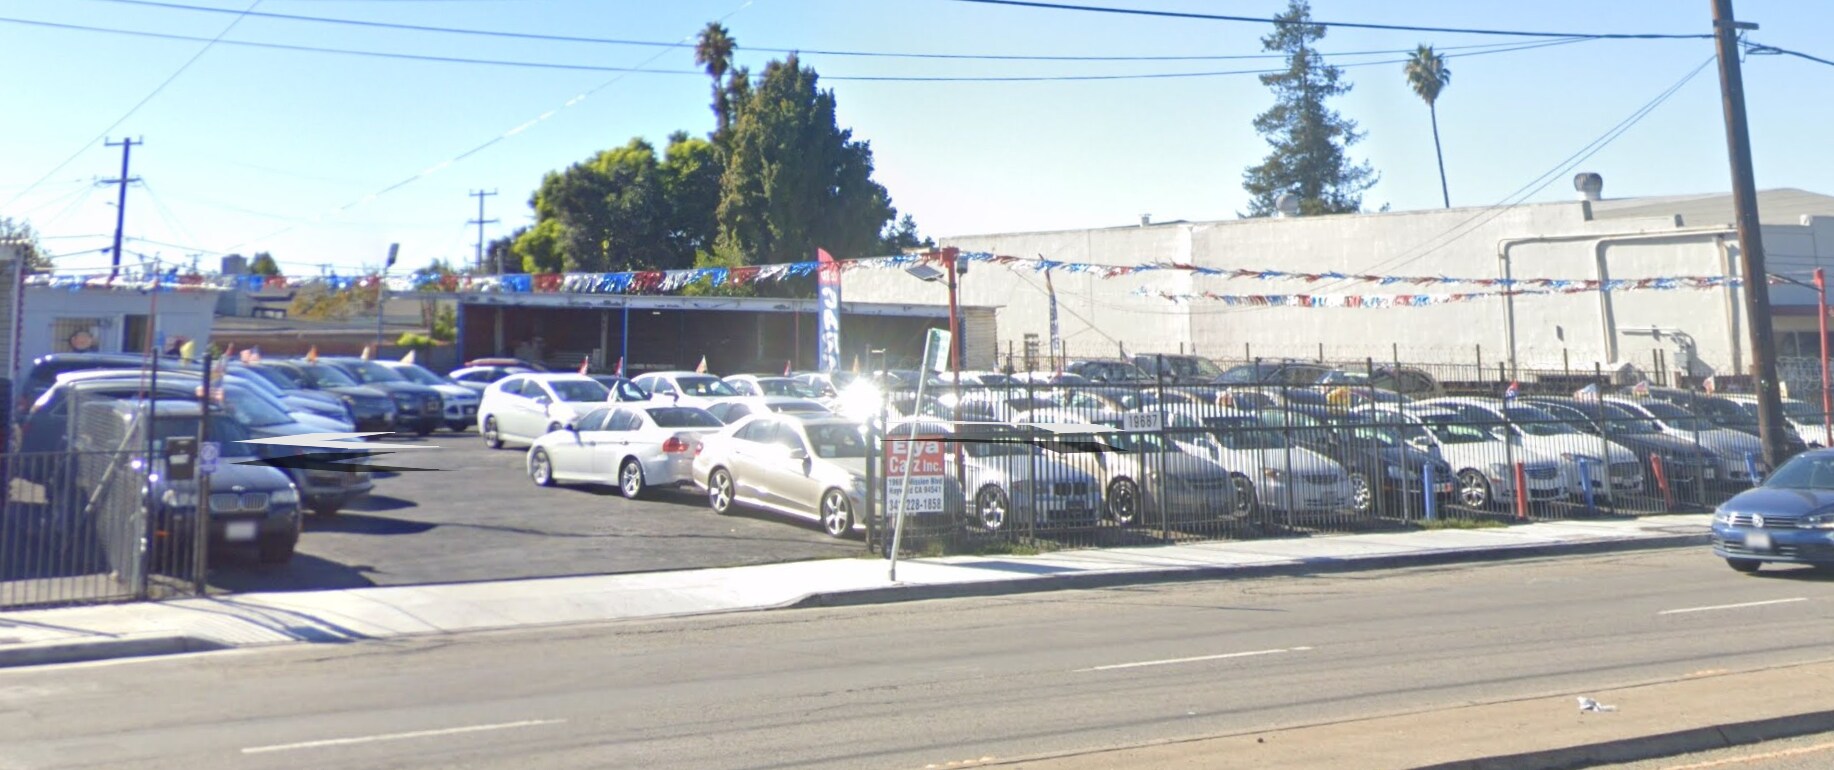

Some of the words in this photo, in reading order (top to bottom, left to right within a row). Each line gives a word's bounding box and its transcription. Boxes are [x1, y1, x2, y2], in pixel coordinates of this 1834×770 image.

[1129, 414, 1157, 428] 19687
[890, 456, 920, 473] Caz
[923, 459, 943, 472] Inc.
[915, 486, 922, 494] CA
[923, 486, 941, 494] 94541
[889, 499, 902, 511] 34
